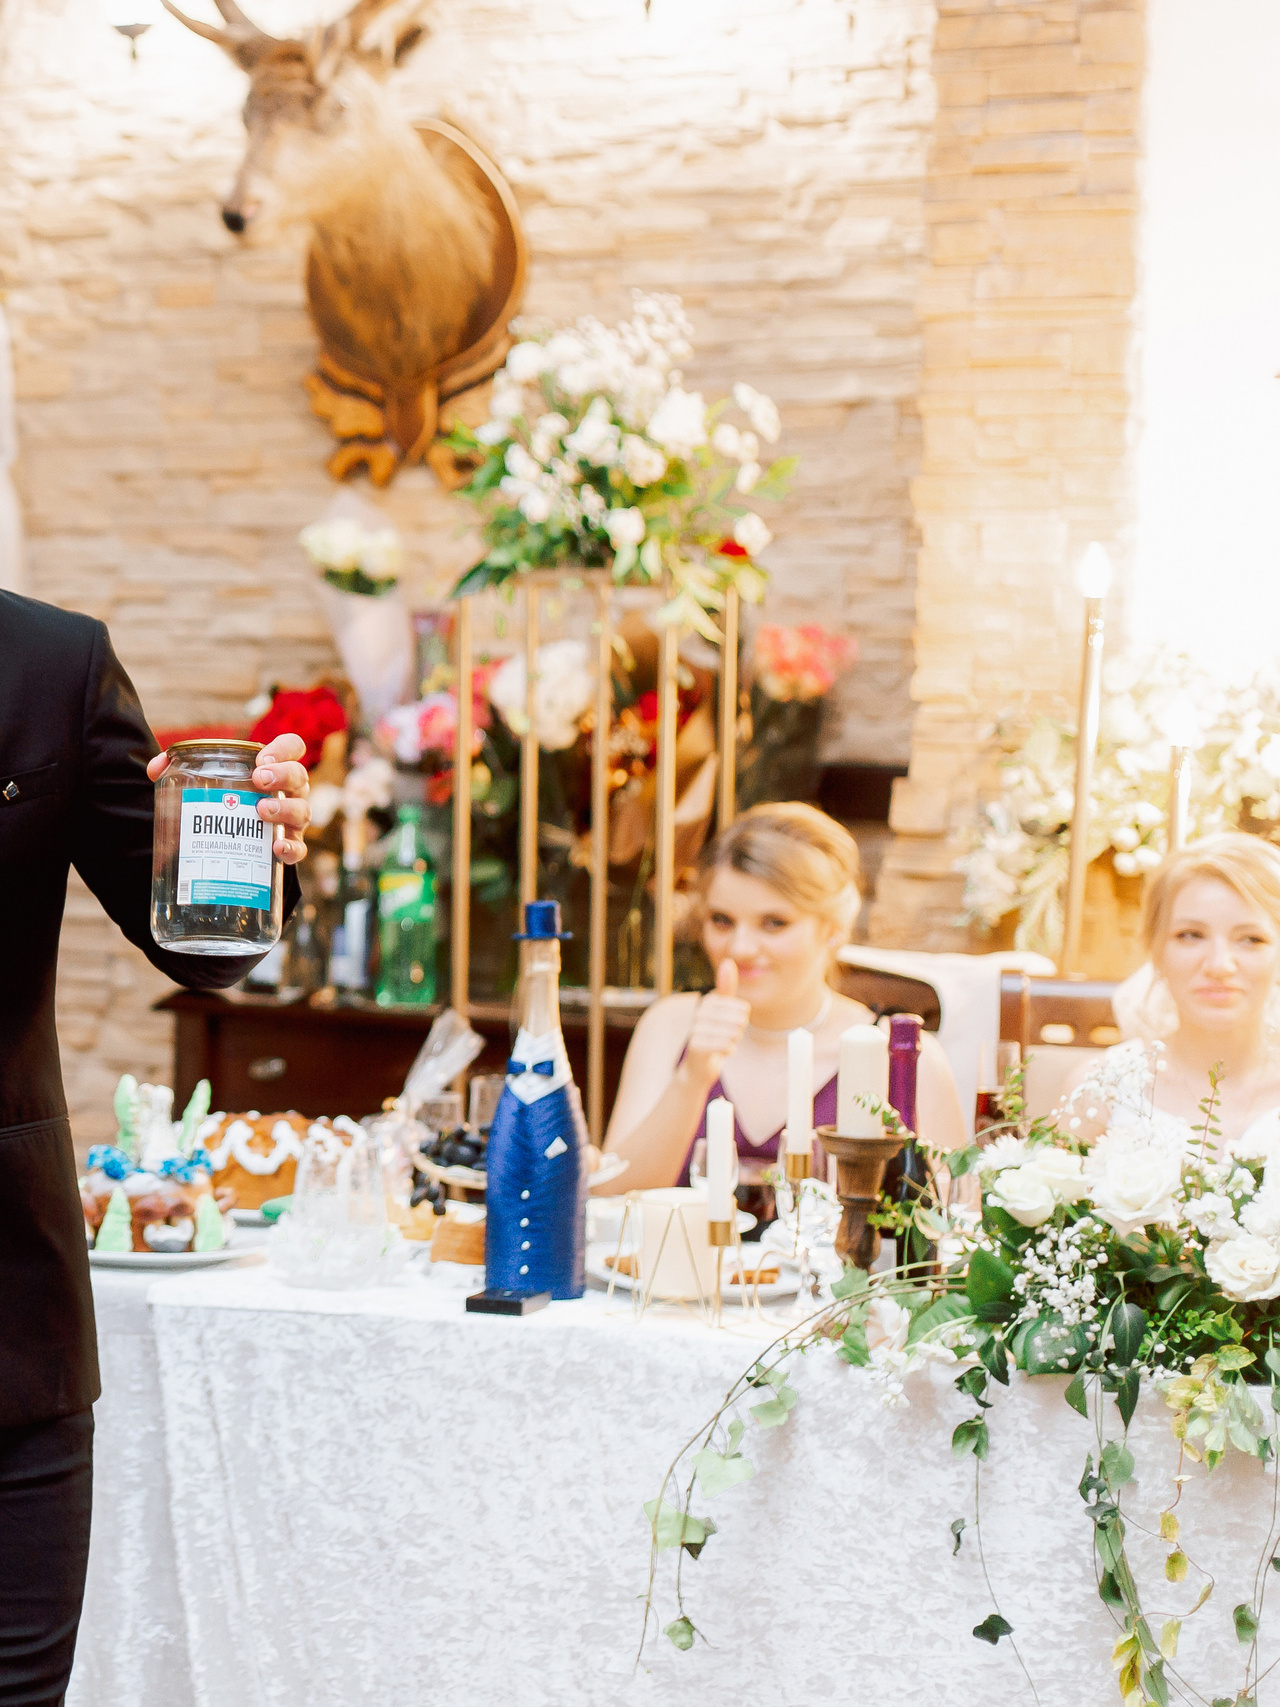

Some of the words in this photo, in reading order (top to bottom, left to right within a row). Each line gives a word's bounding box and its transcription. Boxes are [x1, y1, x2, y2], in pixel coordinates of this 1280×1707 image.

[193, 815, 264, 839] ВАКЦИНА
[192, 840, 241, 851] СПЕЦИАЛЬНАЯ
[244, 843, 263, 854] СЕРИЯ
